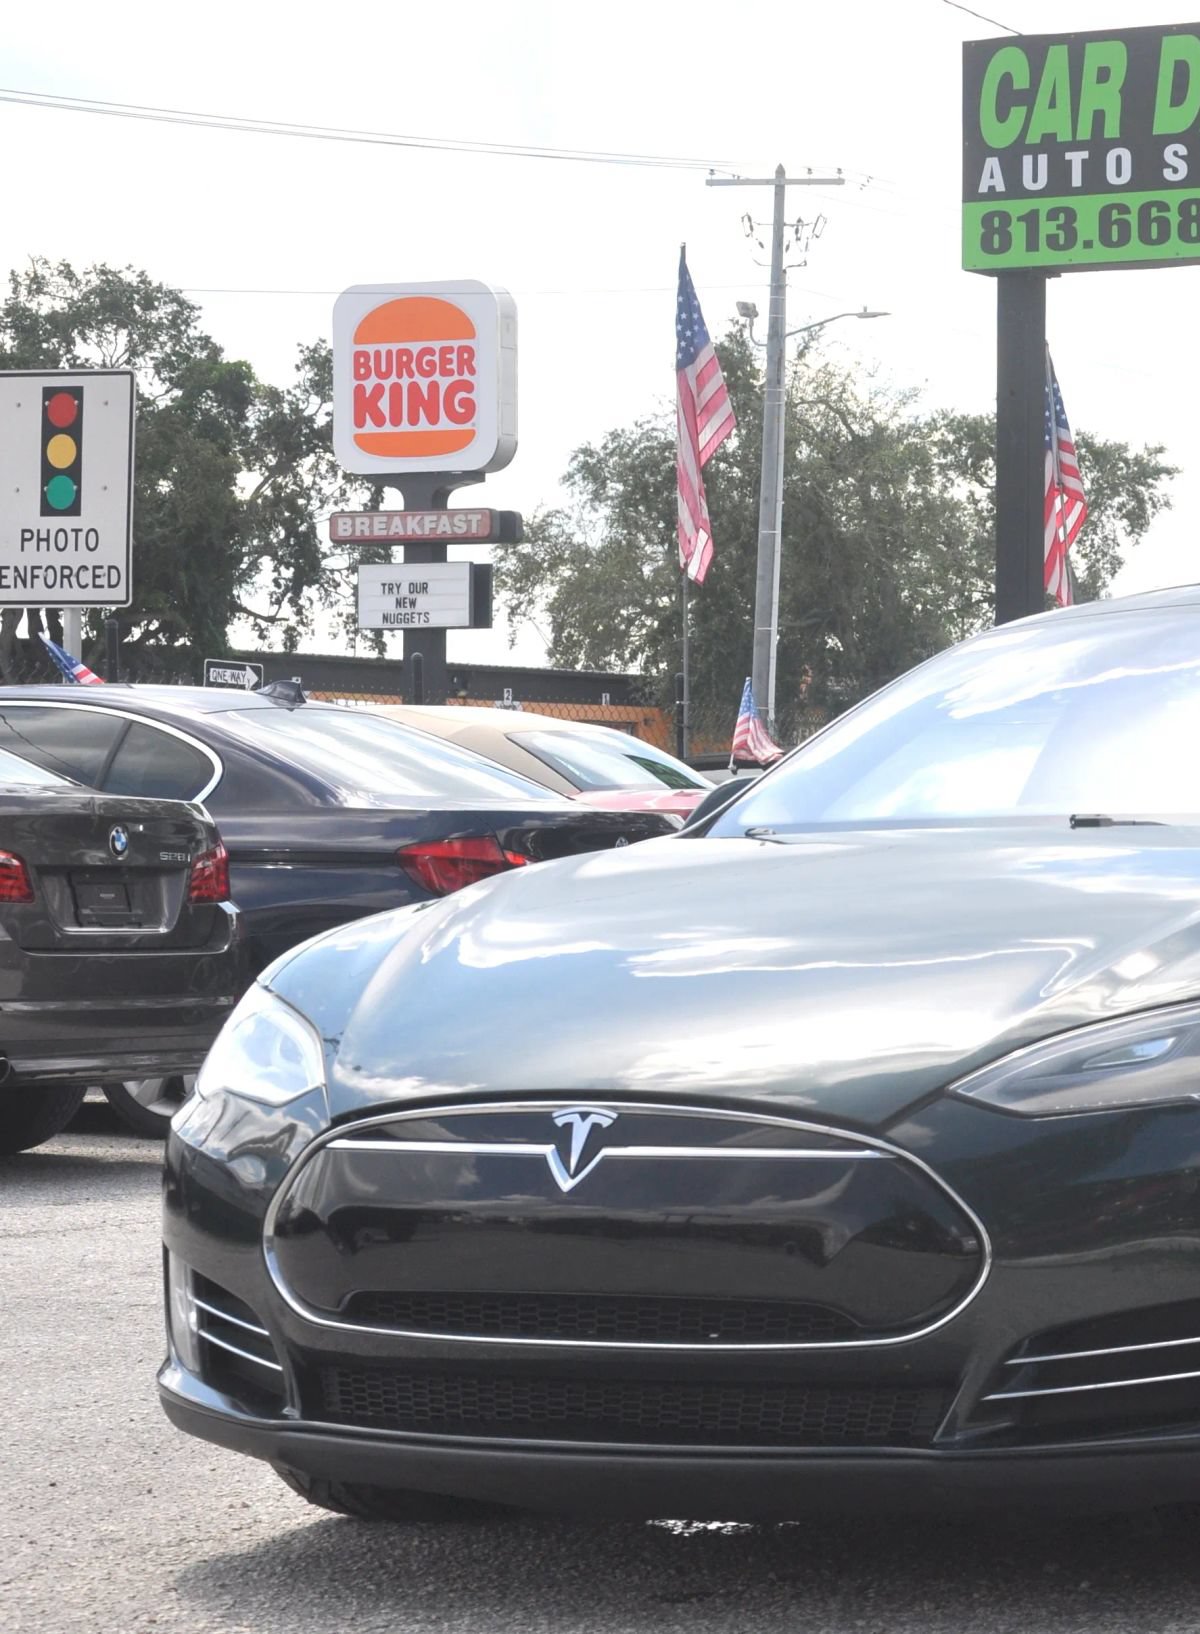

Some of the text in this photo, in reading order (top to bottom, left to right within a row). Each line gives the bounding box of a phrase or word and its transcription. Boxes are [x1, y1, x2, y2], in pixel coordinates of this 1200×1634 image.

[979, 40, 1128, 149] CAR
[978, 147, 1132, 193] AUTO
[353, 345, 476, 381] BURGER
[353, 379, 476, 429] KING
[336, 514, 482, 537] BREAKFAST
[20, 527, 99, 552] PHOTO
[0, 564, 121, 589] ENFORCED
[381, 582, 429, 594] TRY OUR
[395, 597, 417, 609] NEW
[382, 612, 430, 624] NUGGETS
[212, 669, 246, 683] ONE WAY
